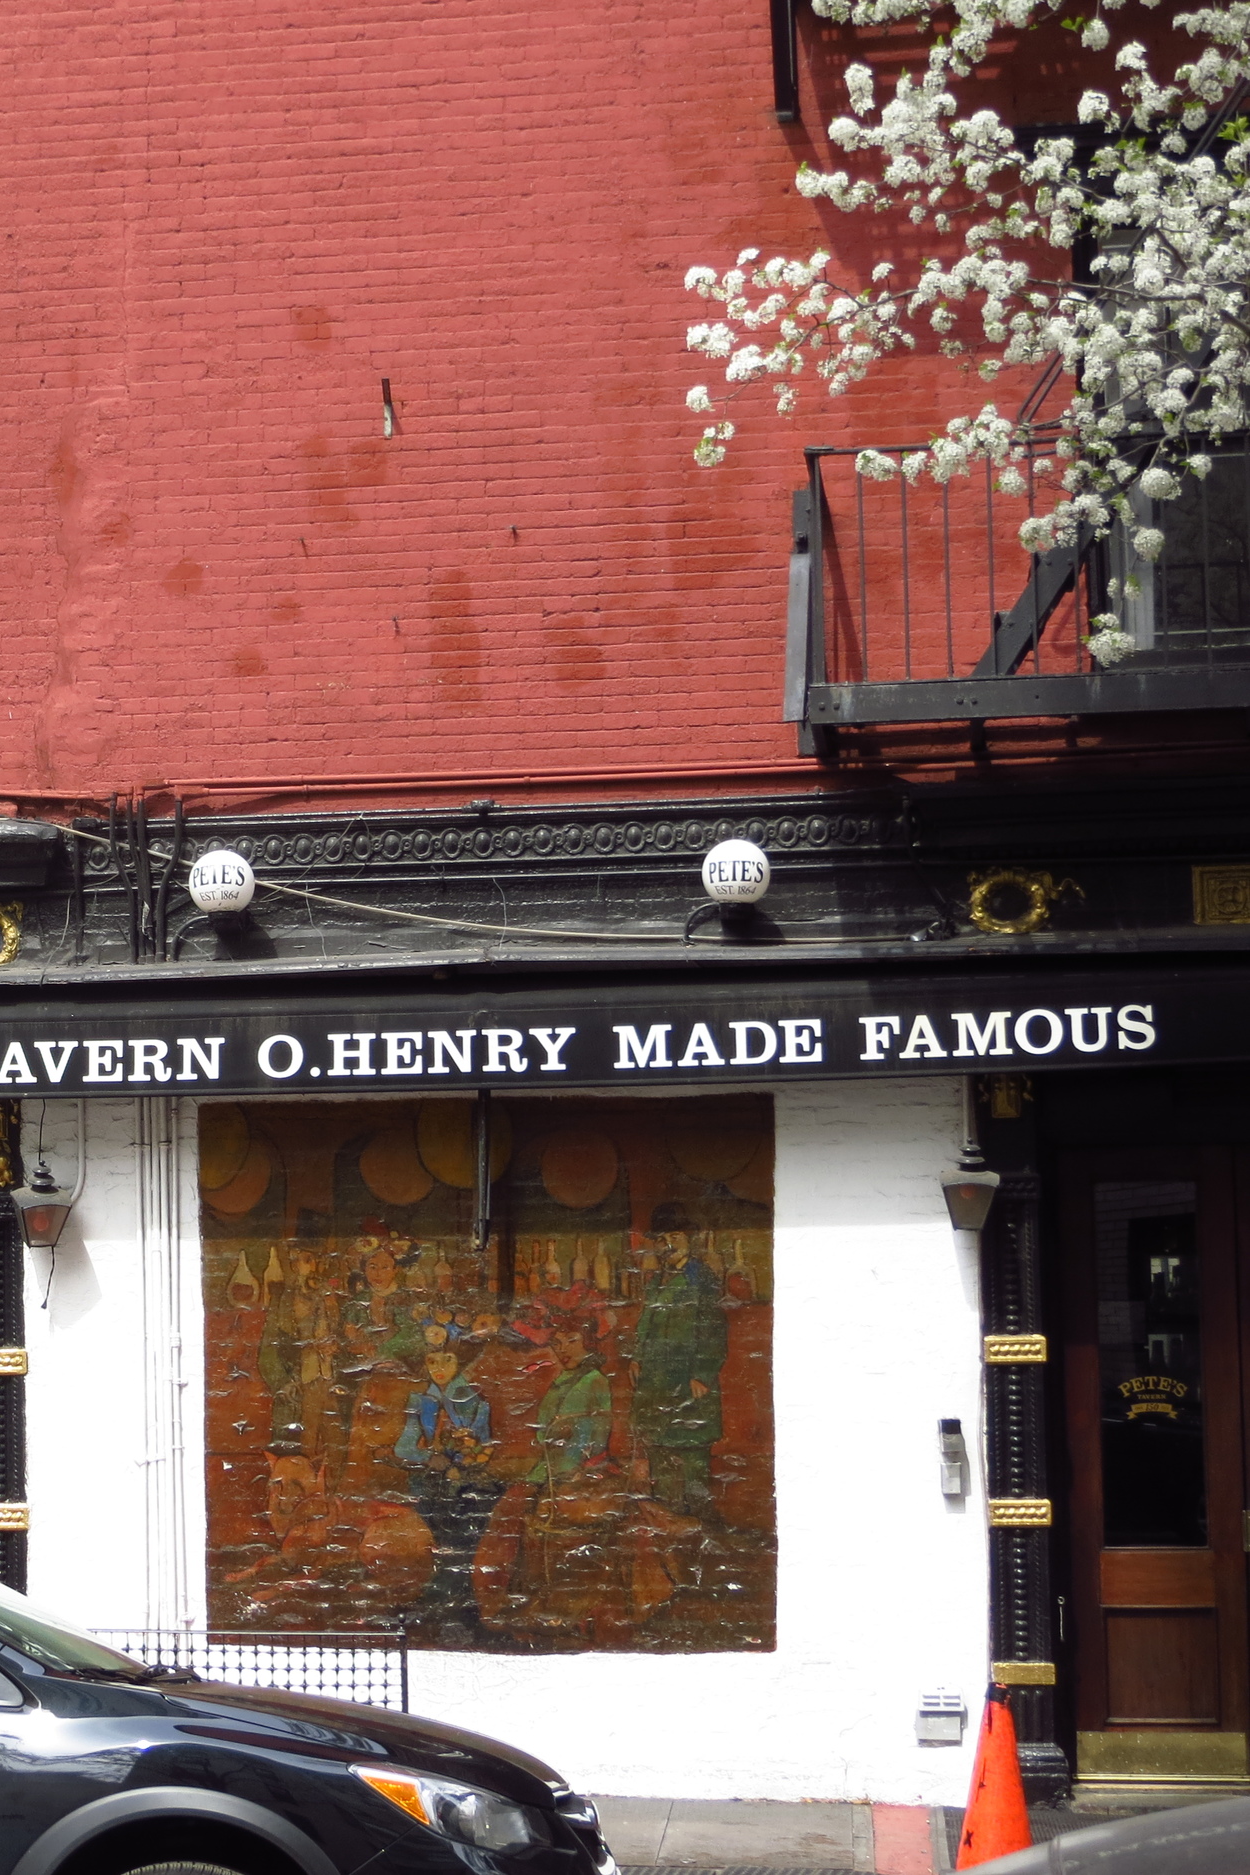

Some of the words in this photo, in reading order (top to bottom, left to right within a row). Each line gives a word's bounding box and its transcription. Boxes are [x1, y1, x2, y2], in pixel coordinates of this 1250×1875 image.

[192, 864, 246, 889] PETE'S
[708, 860, 764, 884] PETE'S
[220, 890, 240, 900] 1864
[737, 885, 757, 895] 1864
[256, 1026, 577, 1080] O.HENRY
[611, 1018, 824, 1070] MADE
[858, 1004, 1157, 1062] FAMOUS
[1117, 1375, 1188, 1398] PETE'S
